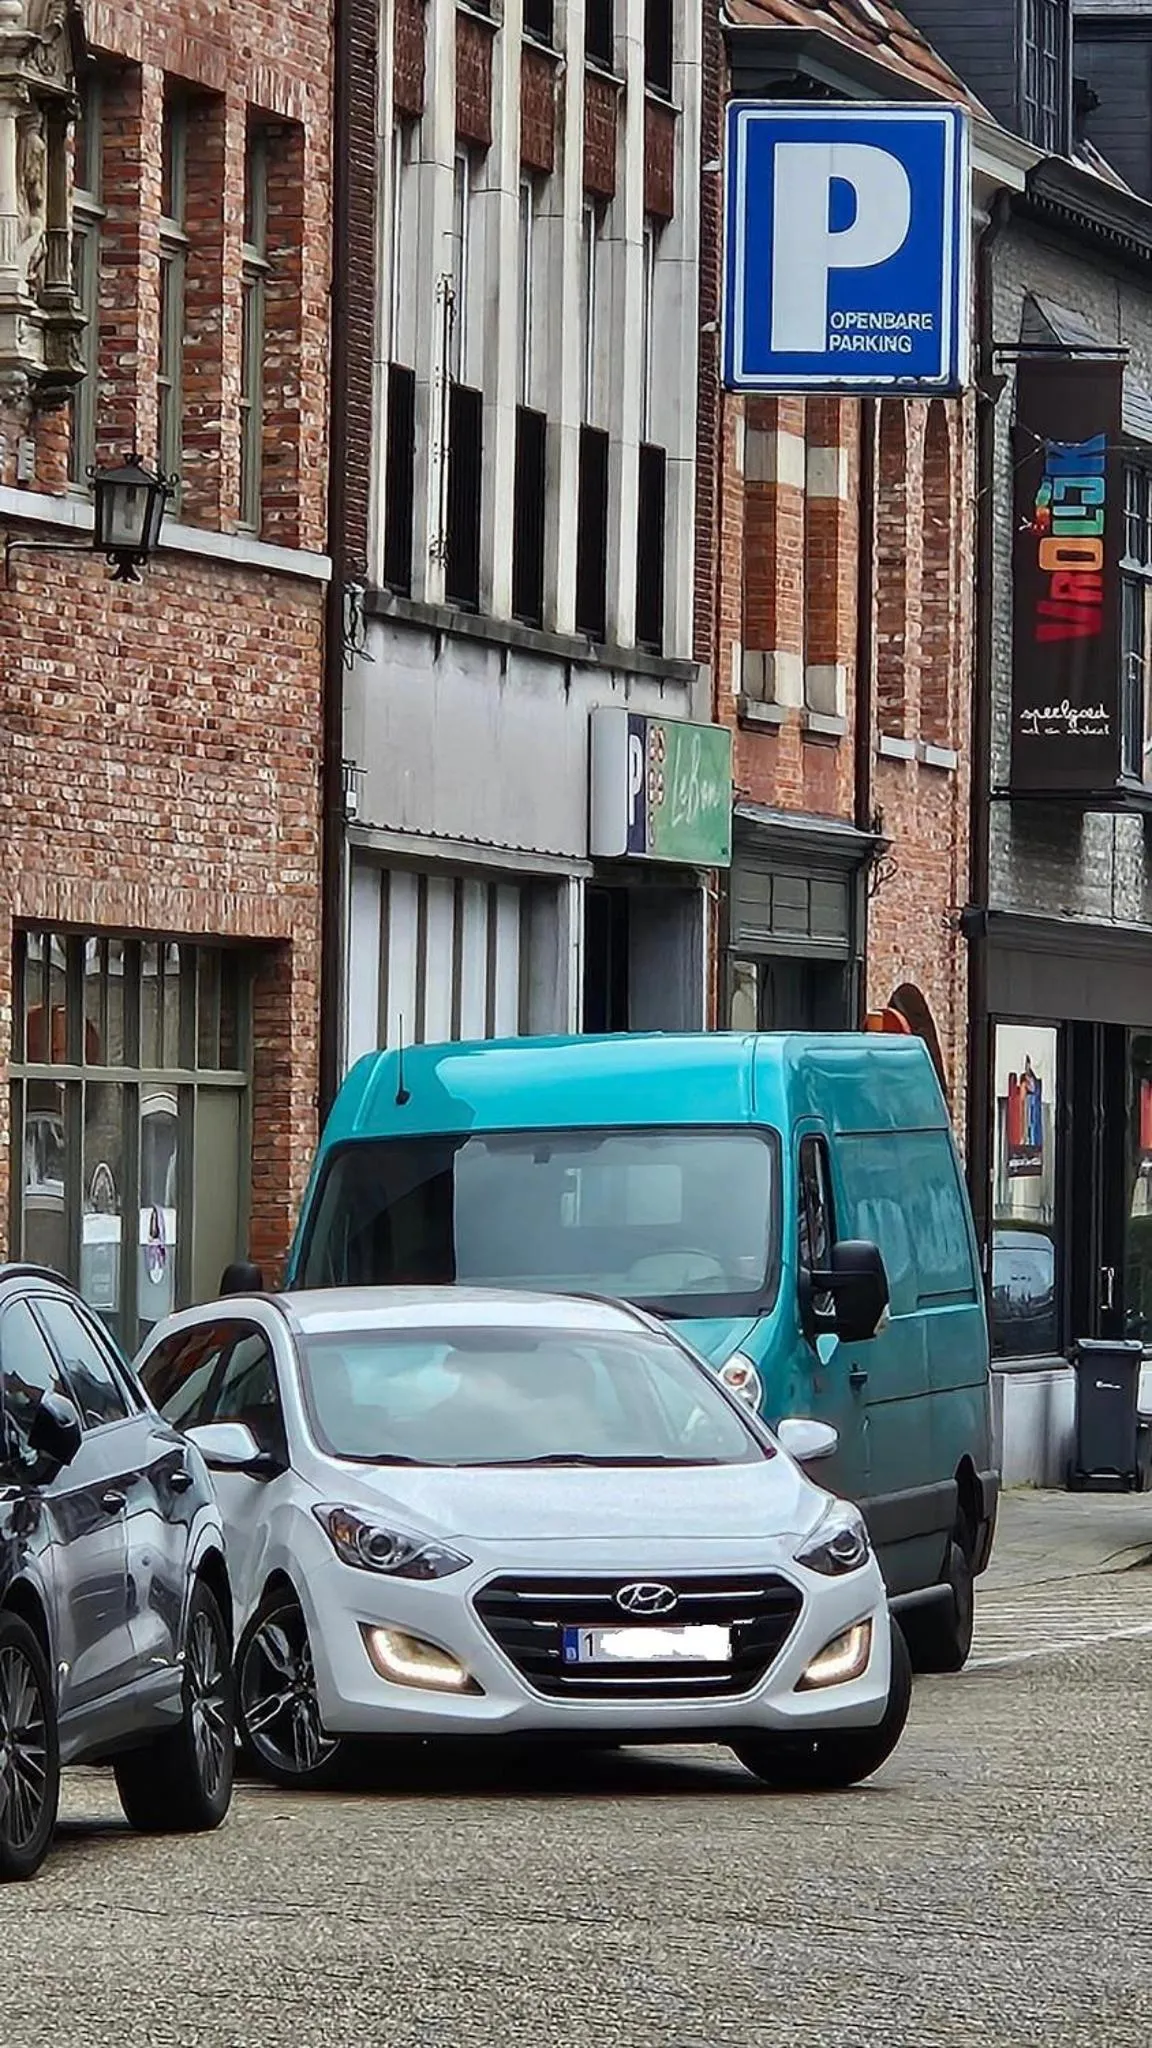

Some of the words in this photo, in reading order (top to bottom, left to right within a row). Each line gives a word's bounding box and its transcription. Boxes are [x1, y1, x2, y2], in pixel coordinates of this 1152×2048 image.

[770, 142, 912, 353] P
[829, 311, 934, 331] OPENBARE
[828, 333, 913, 353] PARKING
[1019, 698, 1111, 731] speelgoed
[628, 733, 643, 827] P
